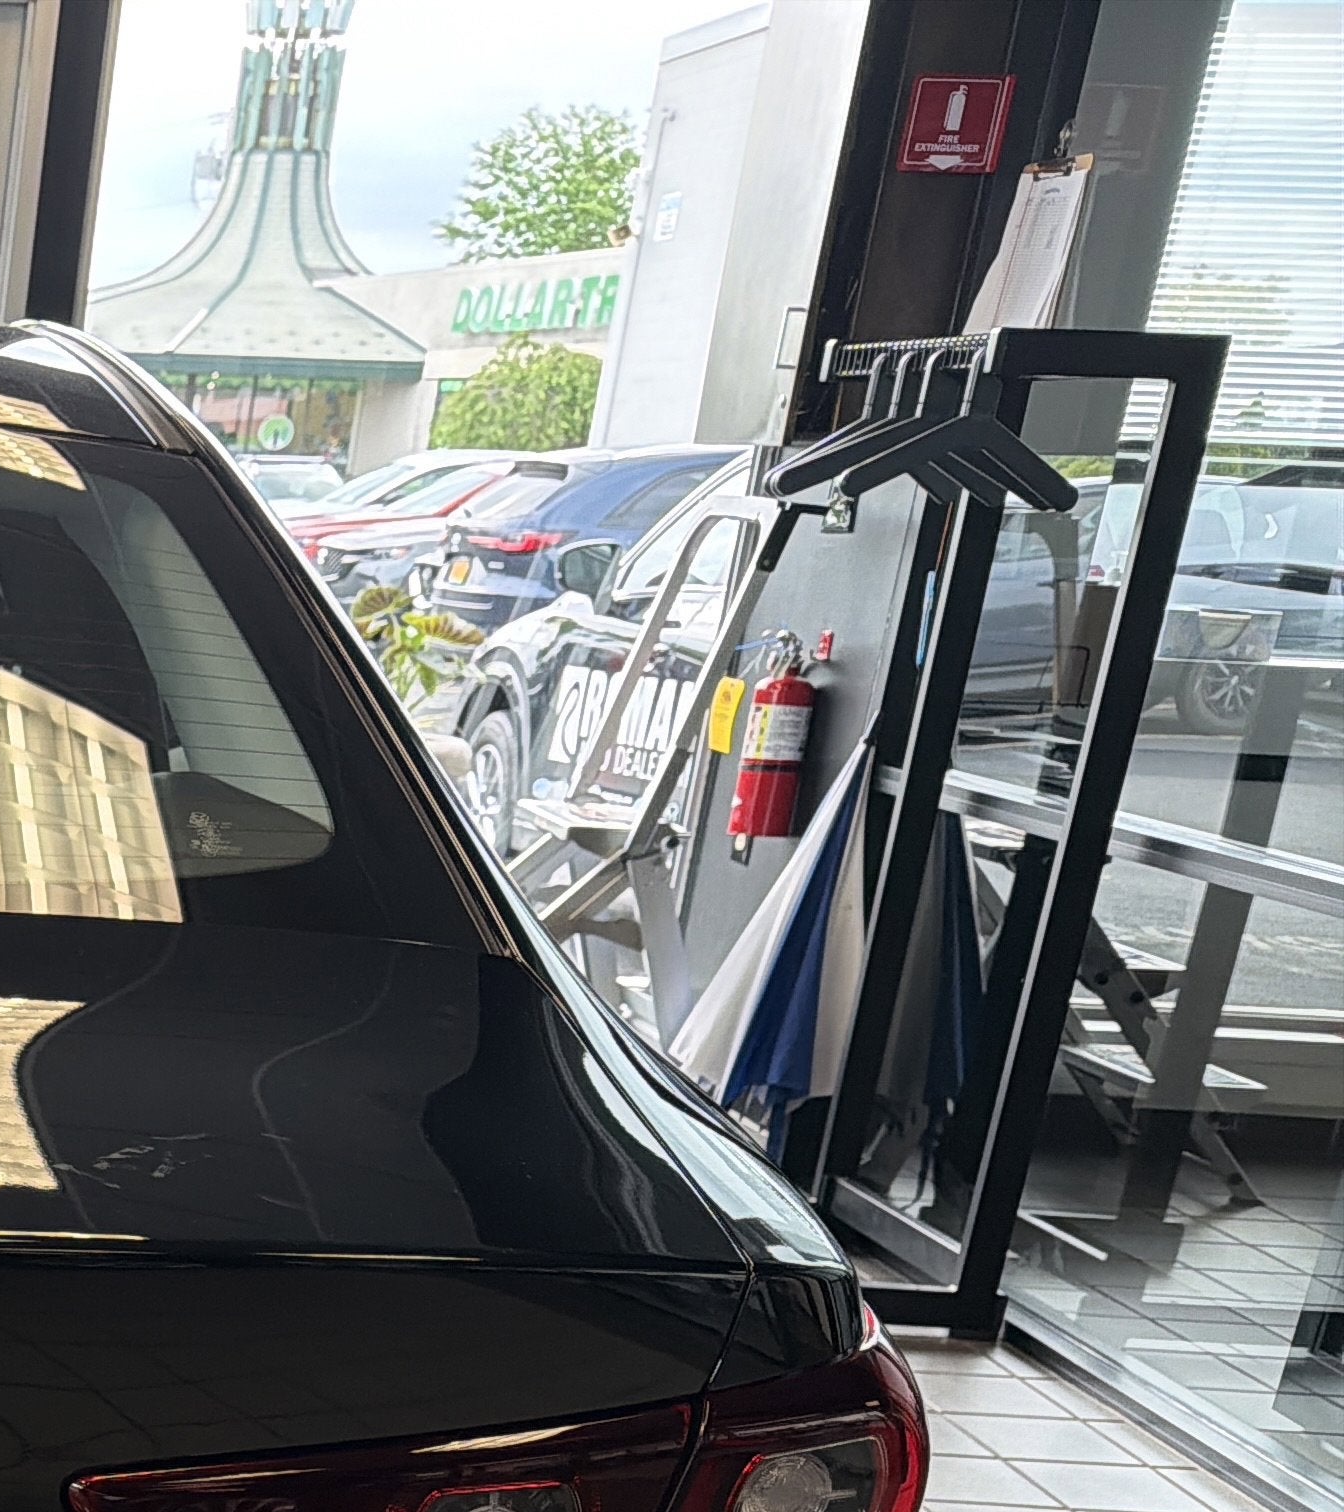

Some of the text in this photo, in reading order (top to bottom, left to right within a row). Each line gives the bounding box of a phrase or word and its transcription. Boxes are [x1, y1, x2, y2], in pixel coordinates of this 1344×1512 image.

[914, 142, 980, 153] EXTINGUISHER
[938, 134, 960, 144] FIRE
[451, 277, 575, 334] DOLLAR
[612, 745, 663, 781] DEALE
